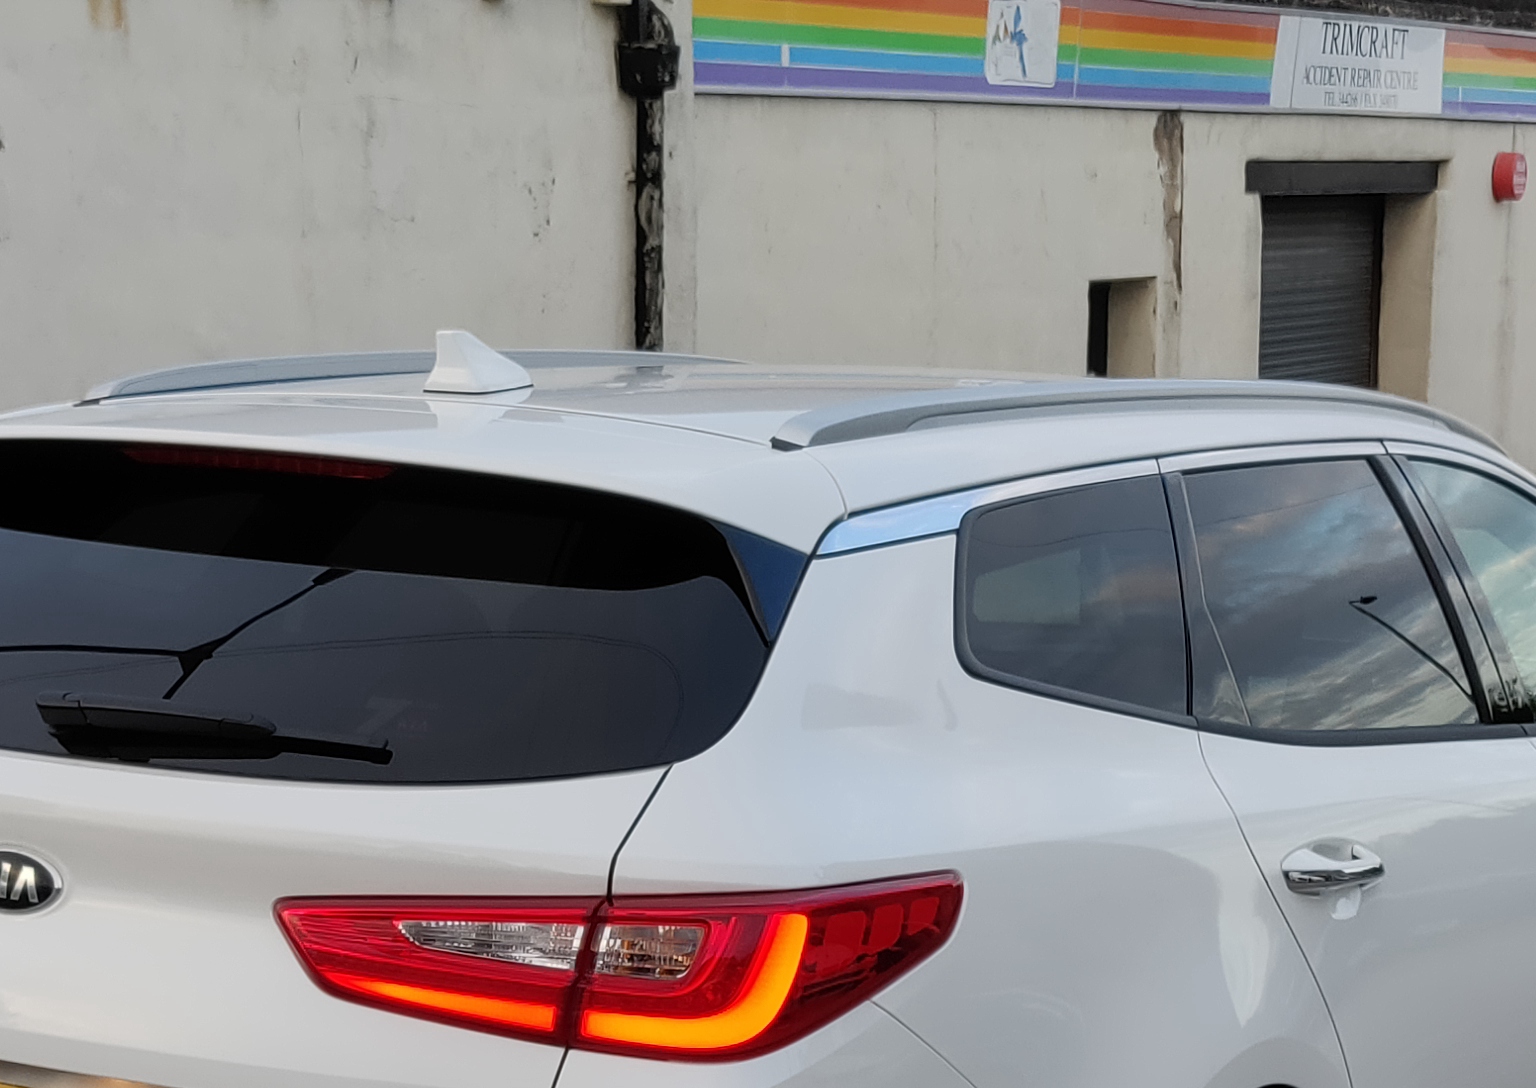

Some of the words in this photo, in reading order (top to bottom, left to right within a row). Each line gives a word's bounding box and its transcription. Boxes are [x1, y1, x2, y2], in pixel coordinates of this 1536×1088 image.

[1321, 21, 1409, 60] TRIMCRAFT
[1303, 65, 1349, 88] ACCIDENT
[1350, 67, 1382, 89] REPAIR
[1384, 69, 1419, 91] CENTRE
